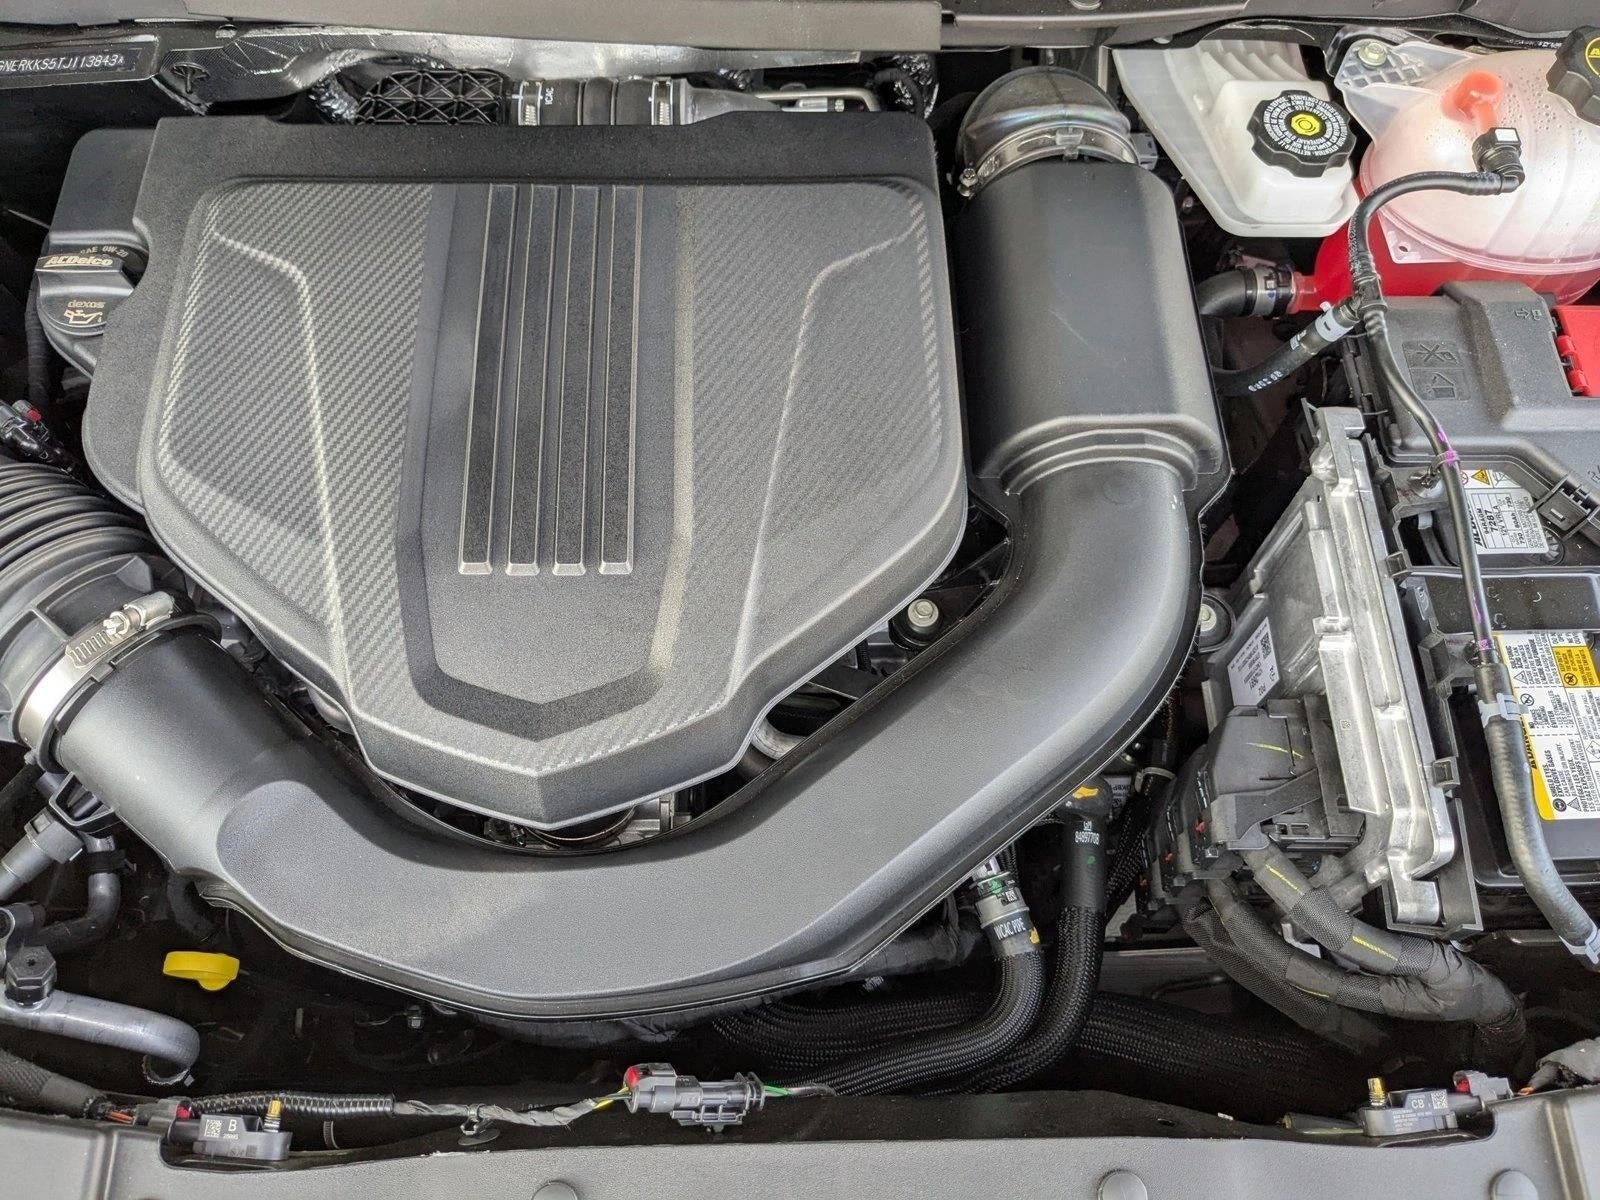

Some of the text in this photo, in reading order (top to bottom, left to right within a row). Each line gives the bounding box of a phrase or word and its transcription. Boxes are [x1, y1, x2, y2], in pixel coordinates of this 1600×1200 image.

[102, 246, 128, 258] 0W-20
[44, 255, 113, 267] ACDelco
[1504, 496, 1512, 507] 730
[1485, 509, 1498, 532] 7287
[1511, 512, 1519, 528] 80Ah
[1516, 532, 1524, 543] 730
[1547, 710, 1558, 728] ÉVITER
[1544, 750, 1564, 796] EXPLOSIVE GASES
[1572, 774, 1580, 783] LES
[1575, 761, 1588, 788] EXPLOSIFS
[1547, 778, 1558, 796] SHIELD
[1562, 786, 1570, 796] CAN
[1584, 790, 1592, 800] GAZ
[1587, 802, 1596, 811] LES
[1411, 1099, 1425, 1108] CB
[228, 1119, 237, 1132] B
